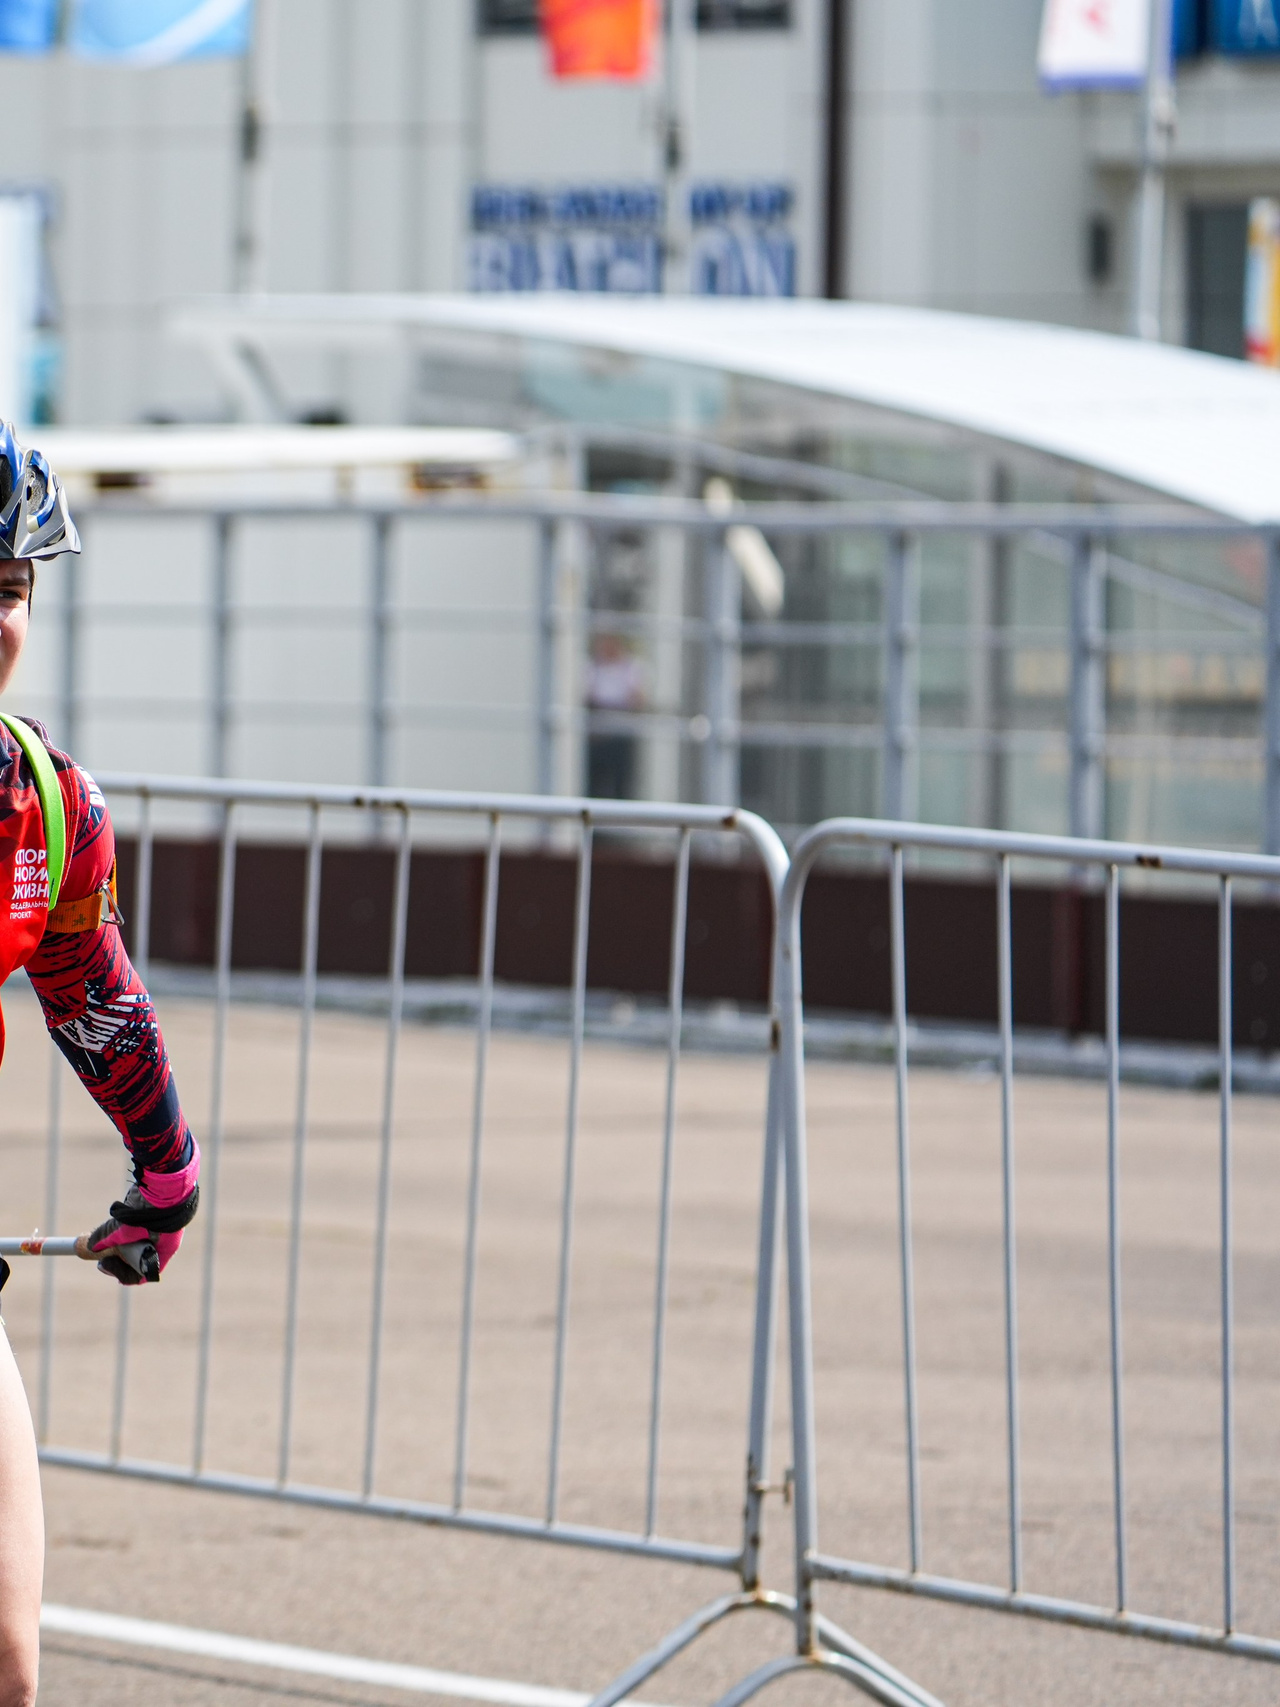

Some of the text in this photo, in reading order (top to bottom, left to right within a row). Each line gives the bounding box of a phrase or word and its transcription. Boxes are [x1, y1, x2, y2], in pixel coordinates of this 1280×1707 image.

[470, 232, 797, 296] BIATHON
[15, 848, 47, 865] СПОР
[14, 866, 49, 883] НОРМ
[10, 900, 49, 910] ФЕДЕРАЛЬНЫ
[9, 910, 32, 920] ПРОЕКТ
